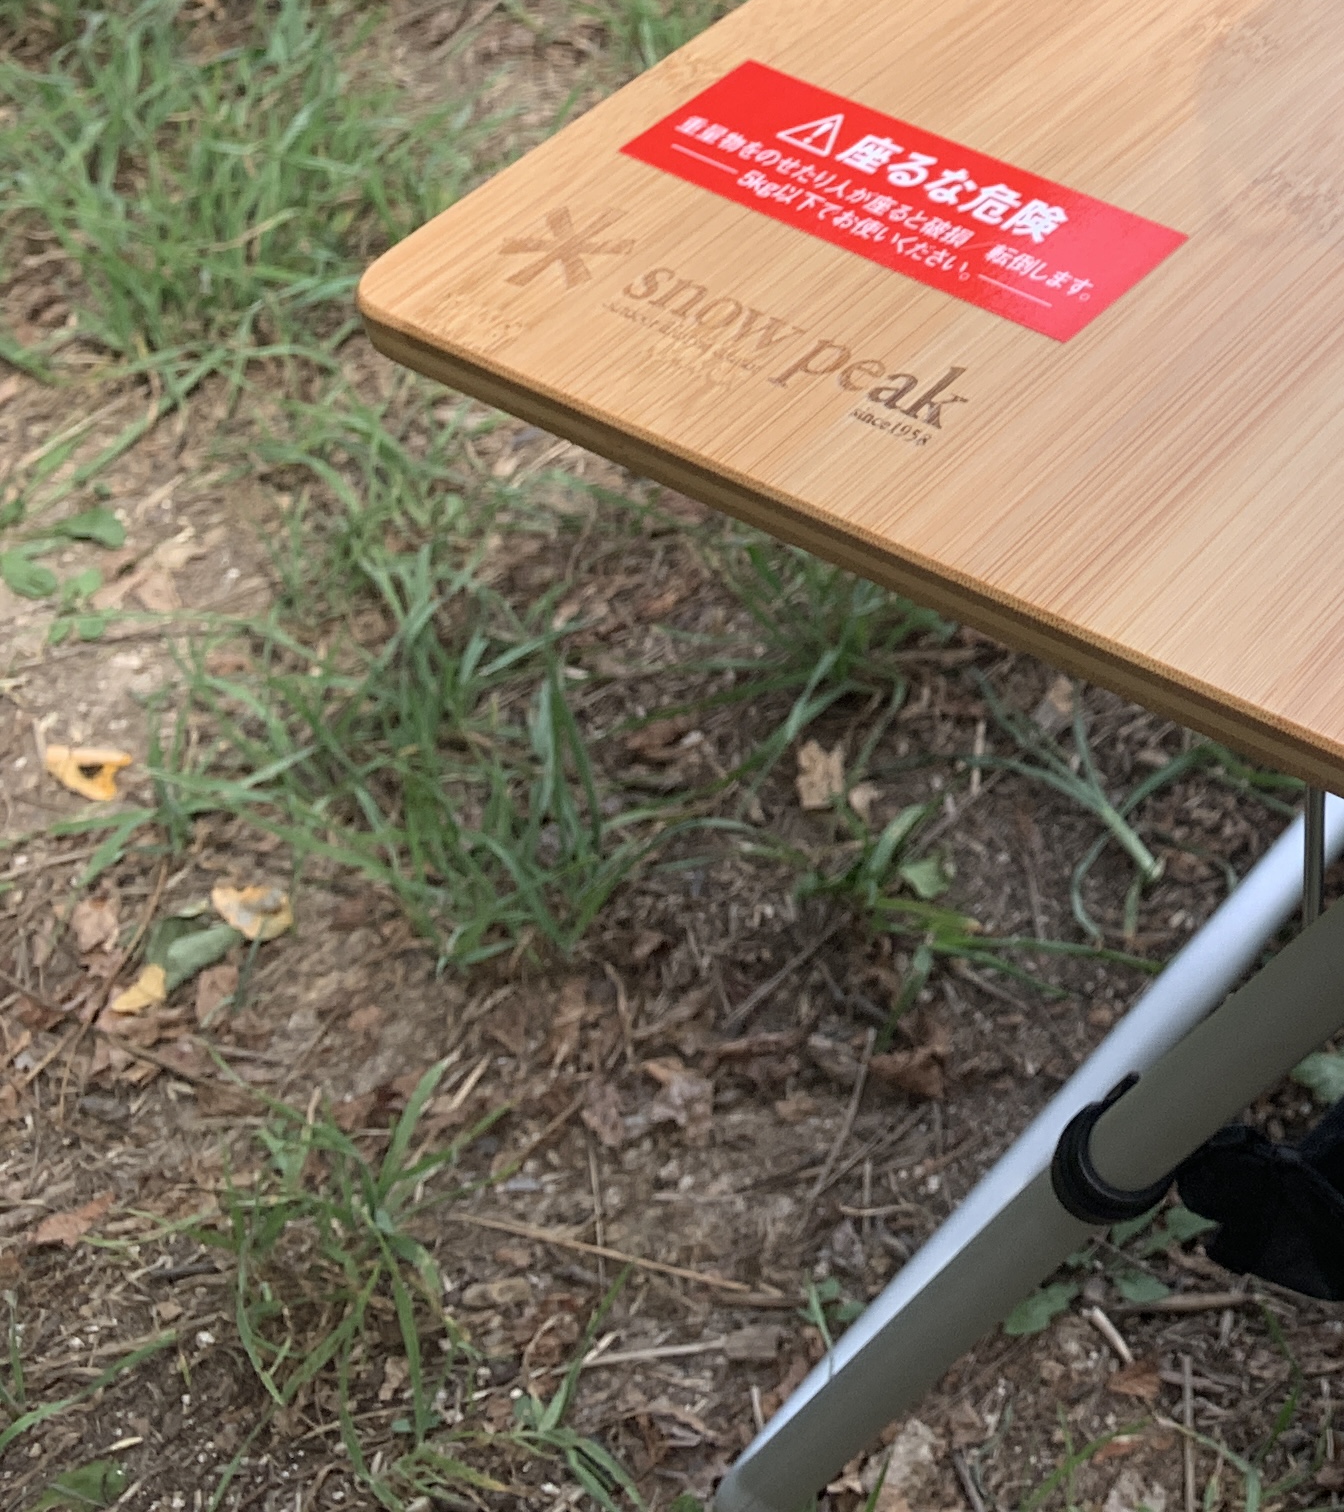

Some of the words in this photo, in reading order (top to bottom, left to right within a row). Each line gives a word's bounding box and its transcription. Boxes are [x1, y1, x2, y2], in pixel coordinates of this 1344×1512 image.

[835, 133, 1070, 244] 座るな危険
[622, 266, 808, 352] snow
[768, 338, 970, 430] peak
[849, 407, 892, 430] since
